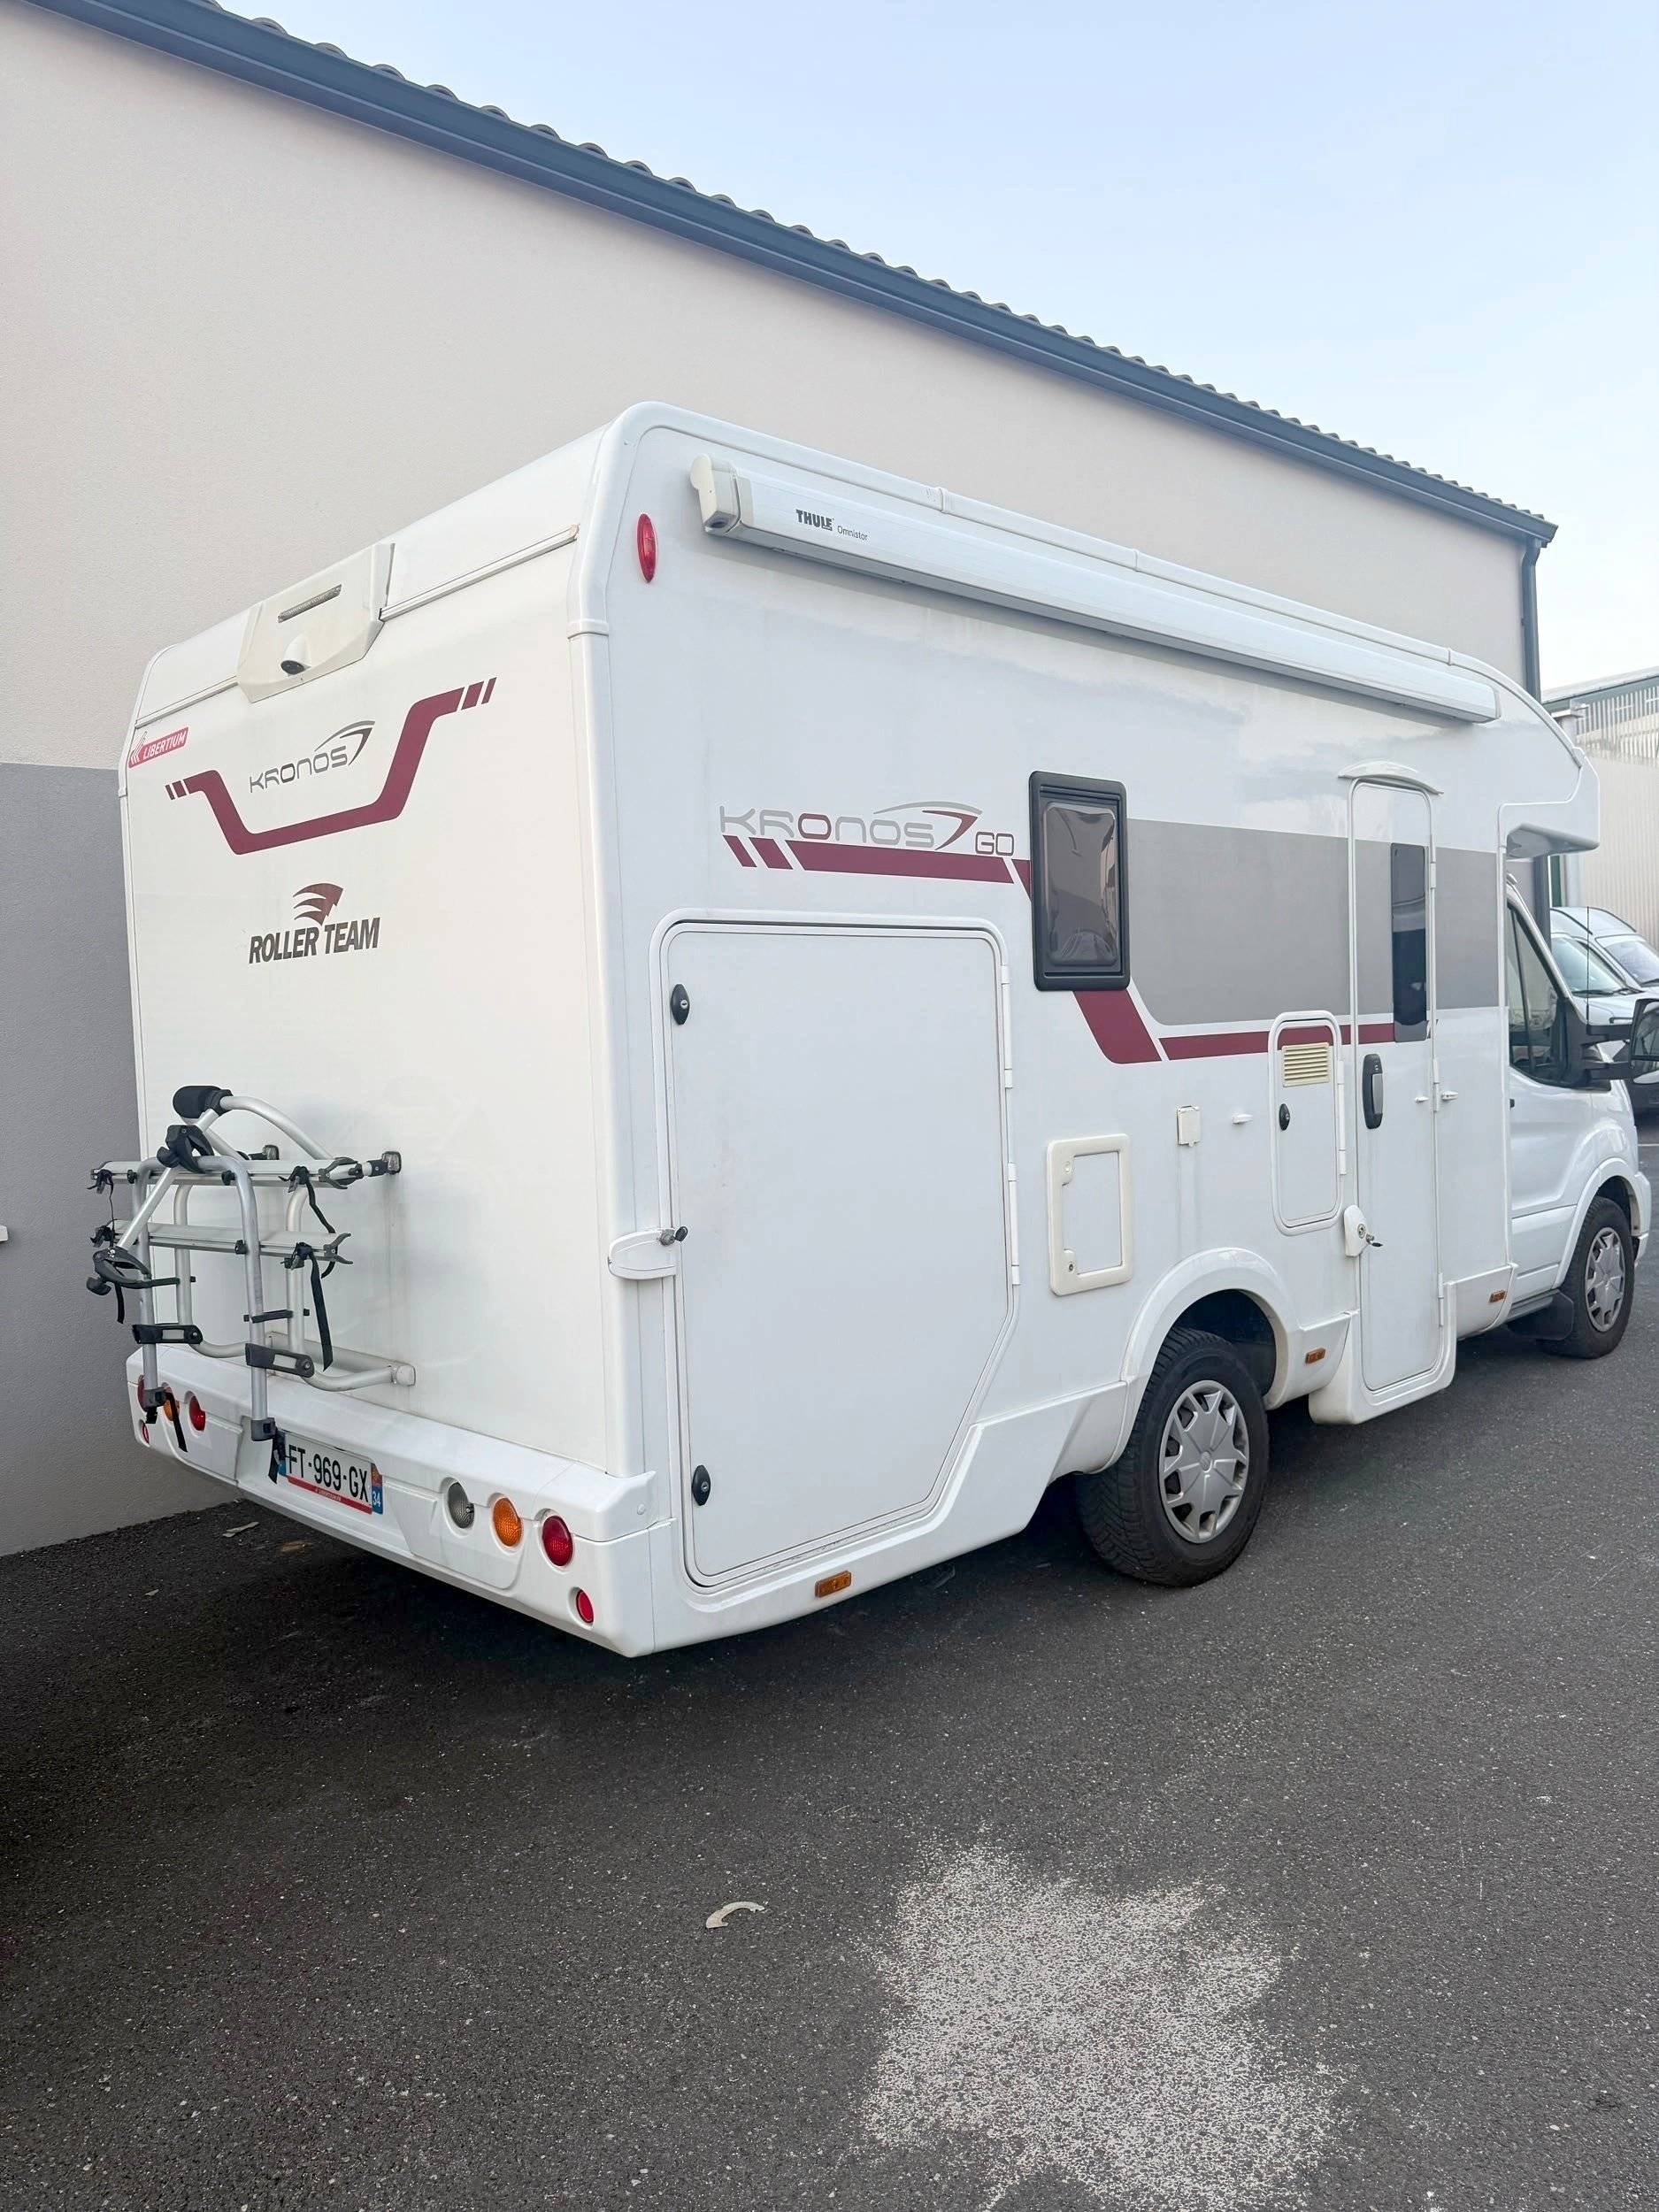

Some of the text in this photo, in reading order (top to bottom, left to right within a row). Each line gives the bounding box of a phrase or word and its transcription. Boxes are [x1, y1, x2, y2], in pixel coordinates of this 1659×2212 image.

[796, 509, 868, 541] THULE Omnistor
[142, 731, 187, 760] LIBERTIUM
[250, 746, 348, 793] KRONOS
[975, 832, 1015, 856] GO
[249, 918, 380, 964] ROLLER TEAM
[288, 1444, 368, 1502] FT-969-GX
[372, 1490, 381, 1508] 34
